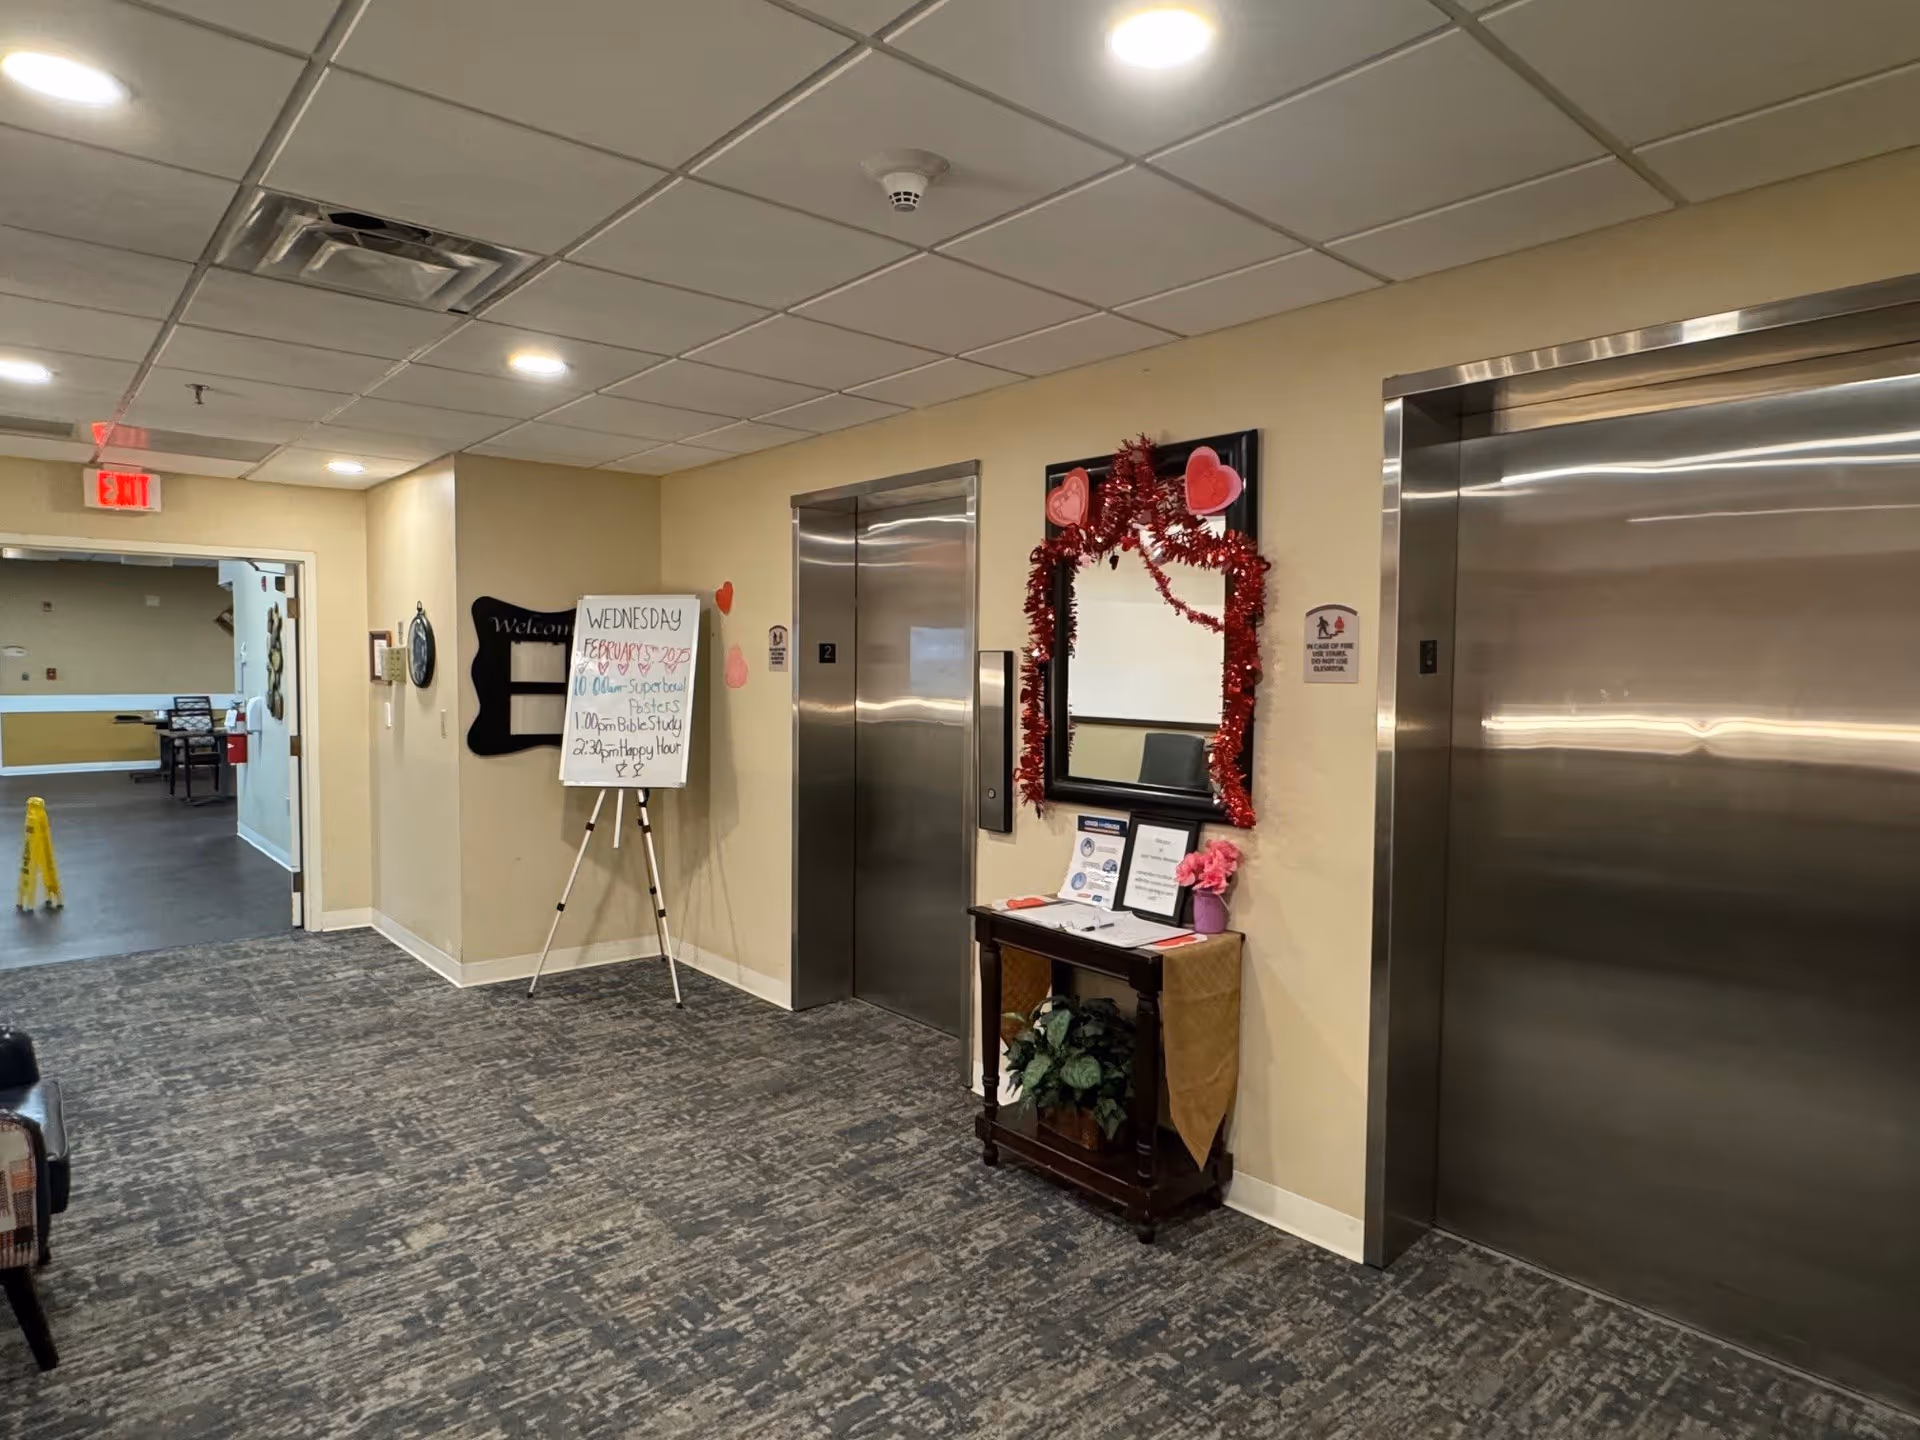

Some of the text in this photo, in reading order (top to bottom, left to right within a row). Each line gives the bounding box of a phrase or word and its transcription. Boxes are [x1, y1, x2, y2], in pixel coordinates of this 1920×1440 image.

[98, 471, 150, 508] EXIT
[586, 606, 682, 632] WEDNESDAY
[583, 638, 643, 662] FEBRUARY
[659, 645, 692, 664] 2025
[824, 645, 832, 658] 2
[618, 714, 646, 733] Bible
[655, 735, 681, 755] Hour
